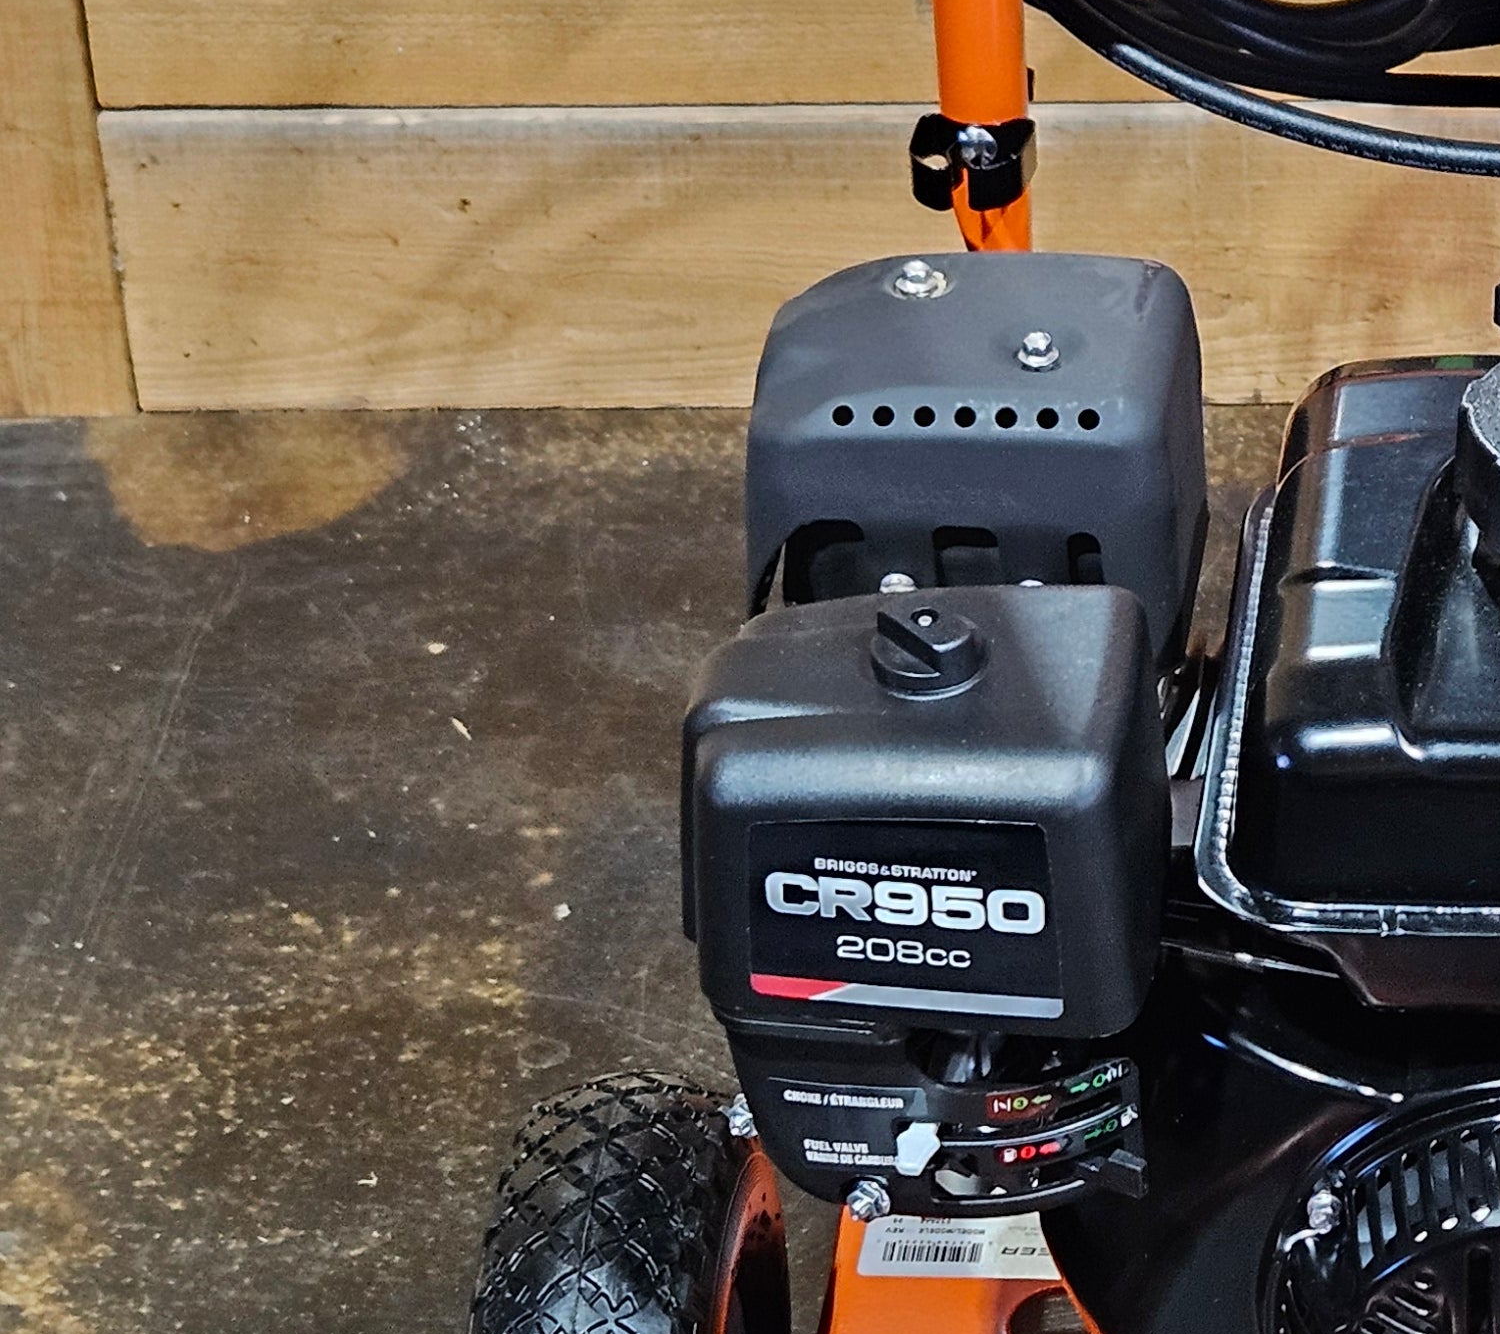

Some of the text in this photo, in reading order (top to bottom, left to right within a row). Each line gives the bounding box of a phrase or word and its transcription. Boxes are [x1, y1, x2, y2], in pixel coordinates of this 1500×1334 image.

[765, 871, 1046, 934] CR950
[836, 935, 971, 968] 208cc
[783, 1089, 822, 1105] CHOKE
[803, 1138, 833, 1152] FUEL
